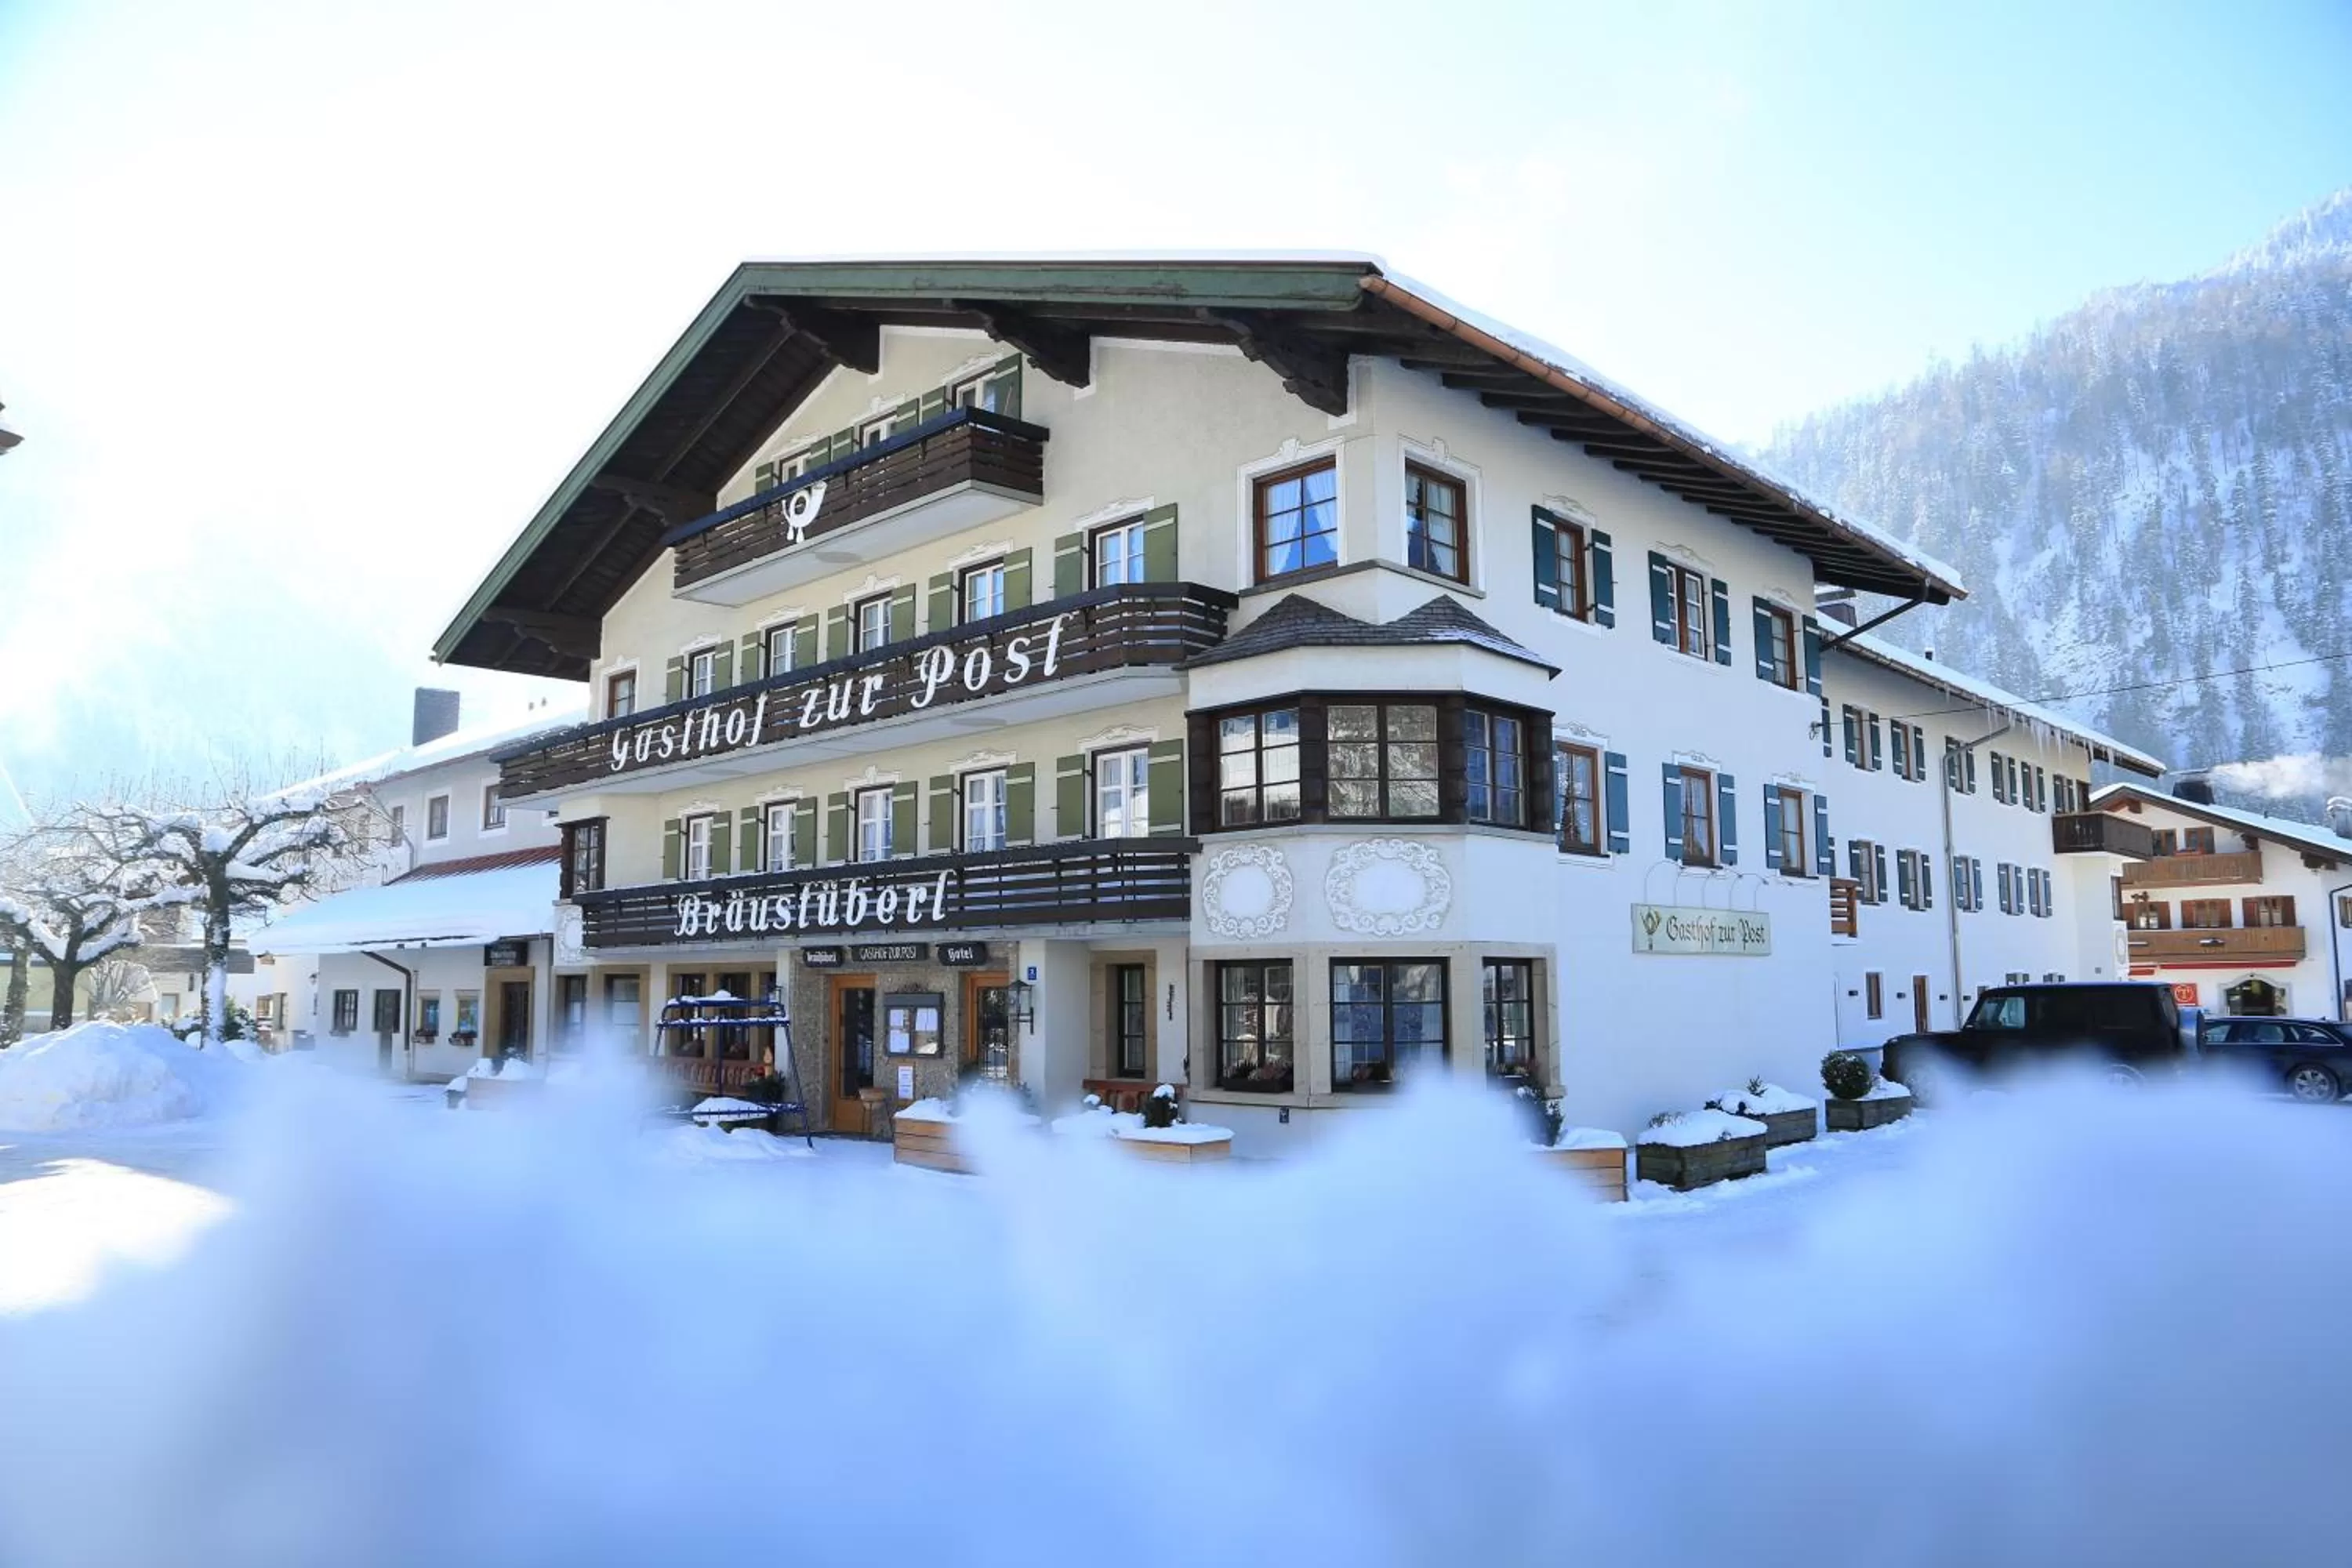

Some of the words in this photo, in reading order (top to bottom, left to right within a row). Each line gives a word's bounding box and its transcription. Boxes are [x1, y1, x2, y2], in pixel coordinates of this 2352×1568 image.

[611, 691, 769, 771] Gasthof
[799, 673, 884, 728] zur
[910, 612, 1074, 709] Post
[673, 869, 957, 936] Bräustüberl
[1665, 914, 1717, 950] Gasthof
[1718, 924, 1735, 943] zur
[1738, 917, 1766, 951] Post
